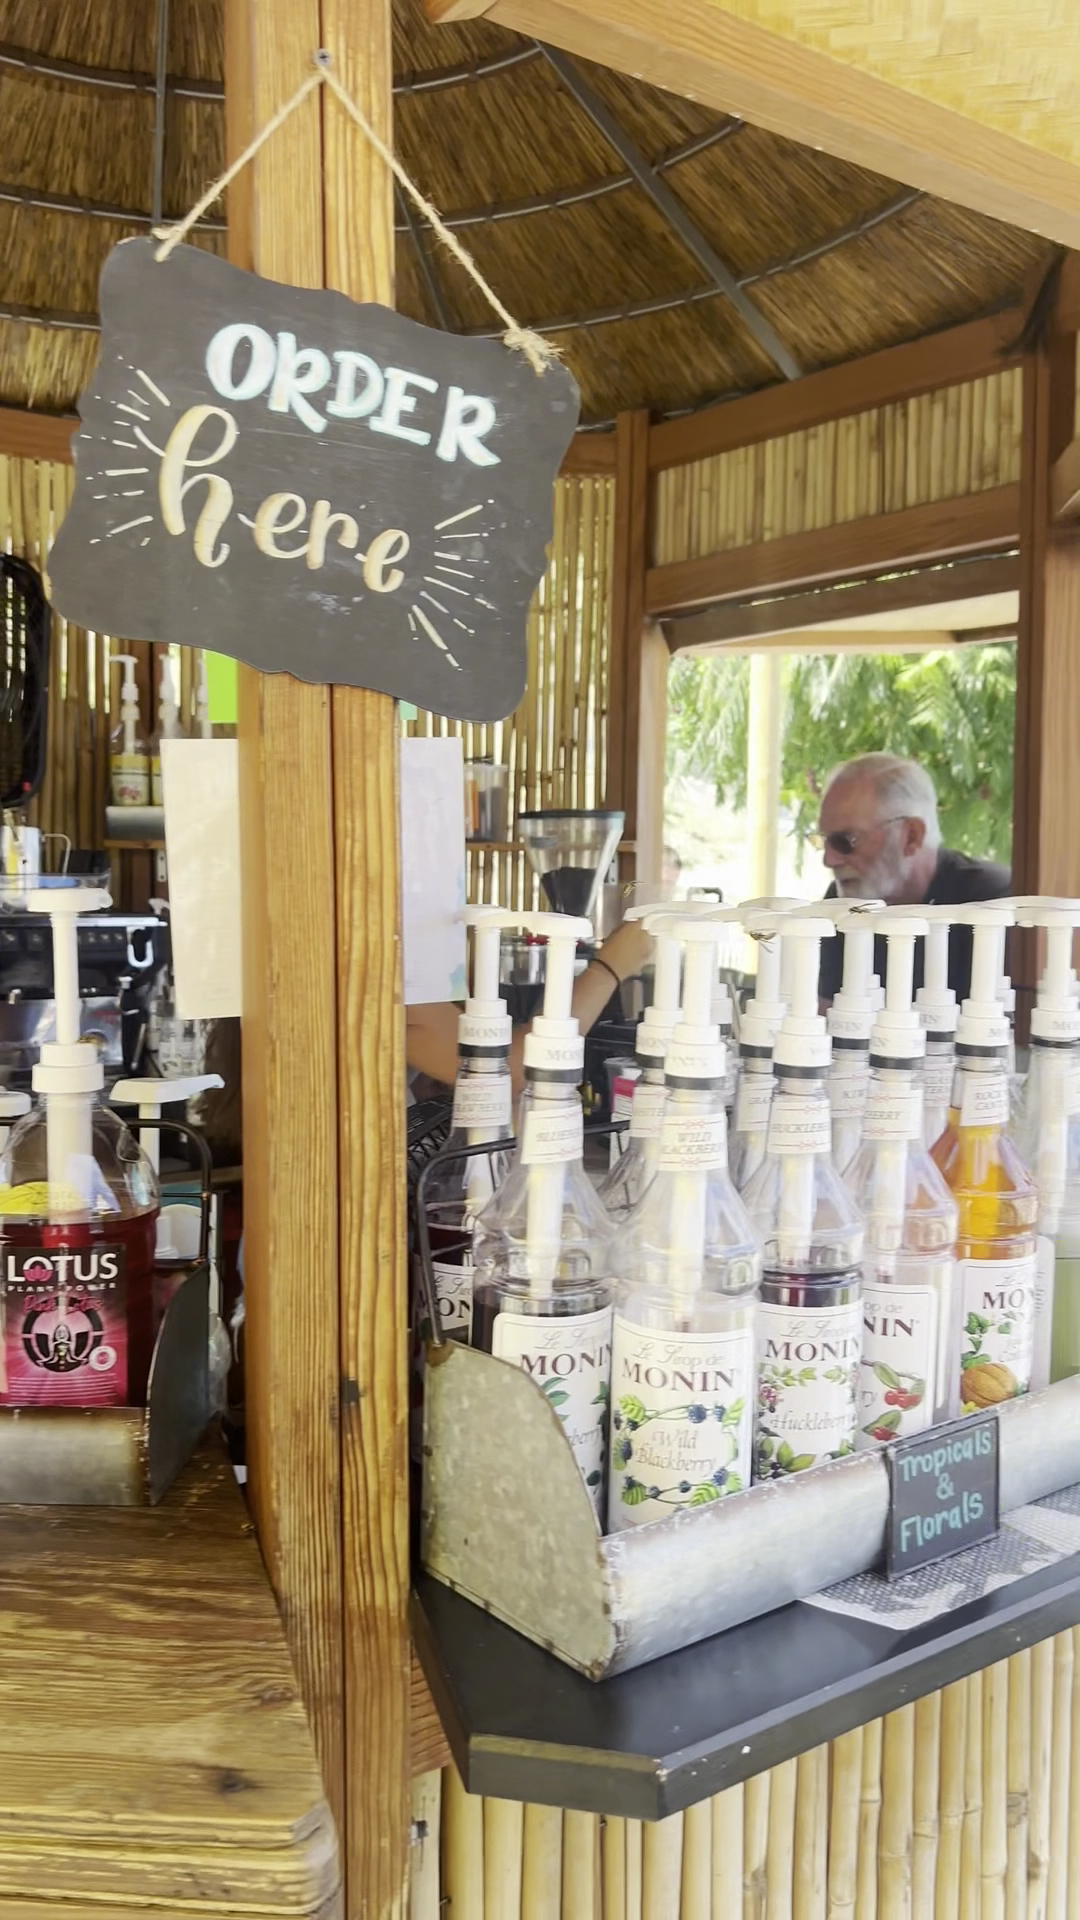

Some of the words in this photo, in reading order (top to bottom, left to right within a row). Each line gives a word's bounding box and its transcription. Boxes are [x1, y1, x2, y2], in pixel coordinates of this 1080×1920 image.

[206, 322, 500, 467] ORDER
[134, 404, 411, 593] here
[7, 1252, 118, 1282] LOTUS
[621, 1357, 738, 1393] MONIN
[634, 1441, 718, 1479] Blackberry
[898, 1429, 993, 1482] Tropicals
[935, 1472, 955, 1500] &
[900, 1491, 985, 1553] Florals
